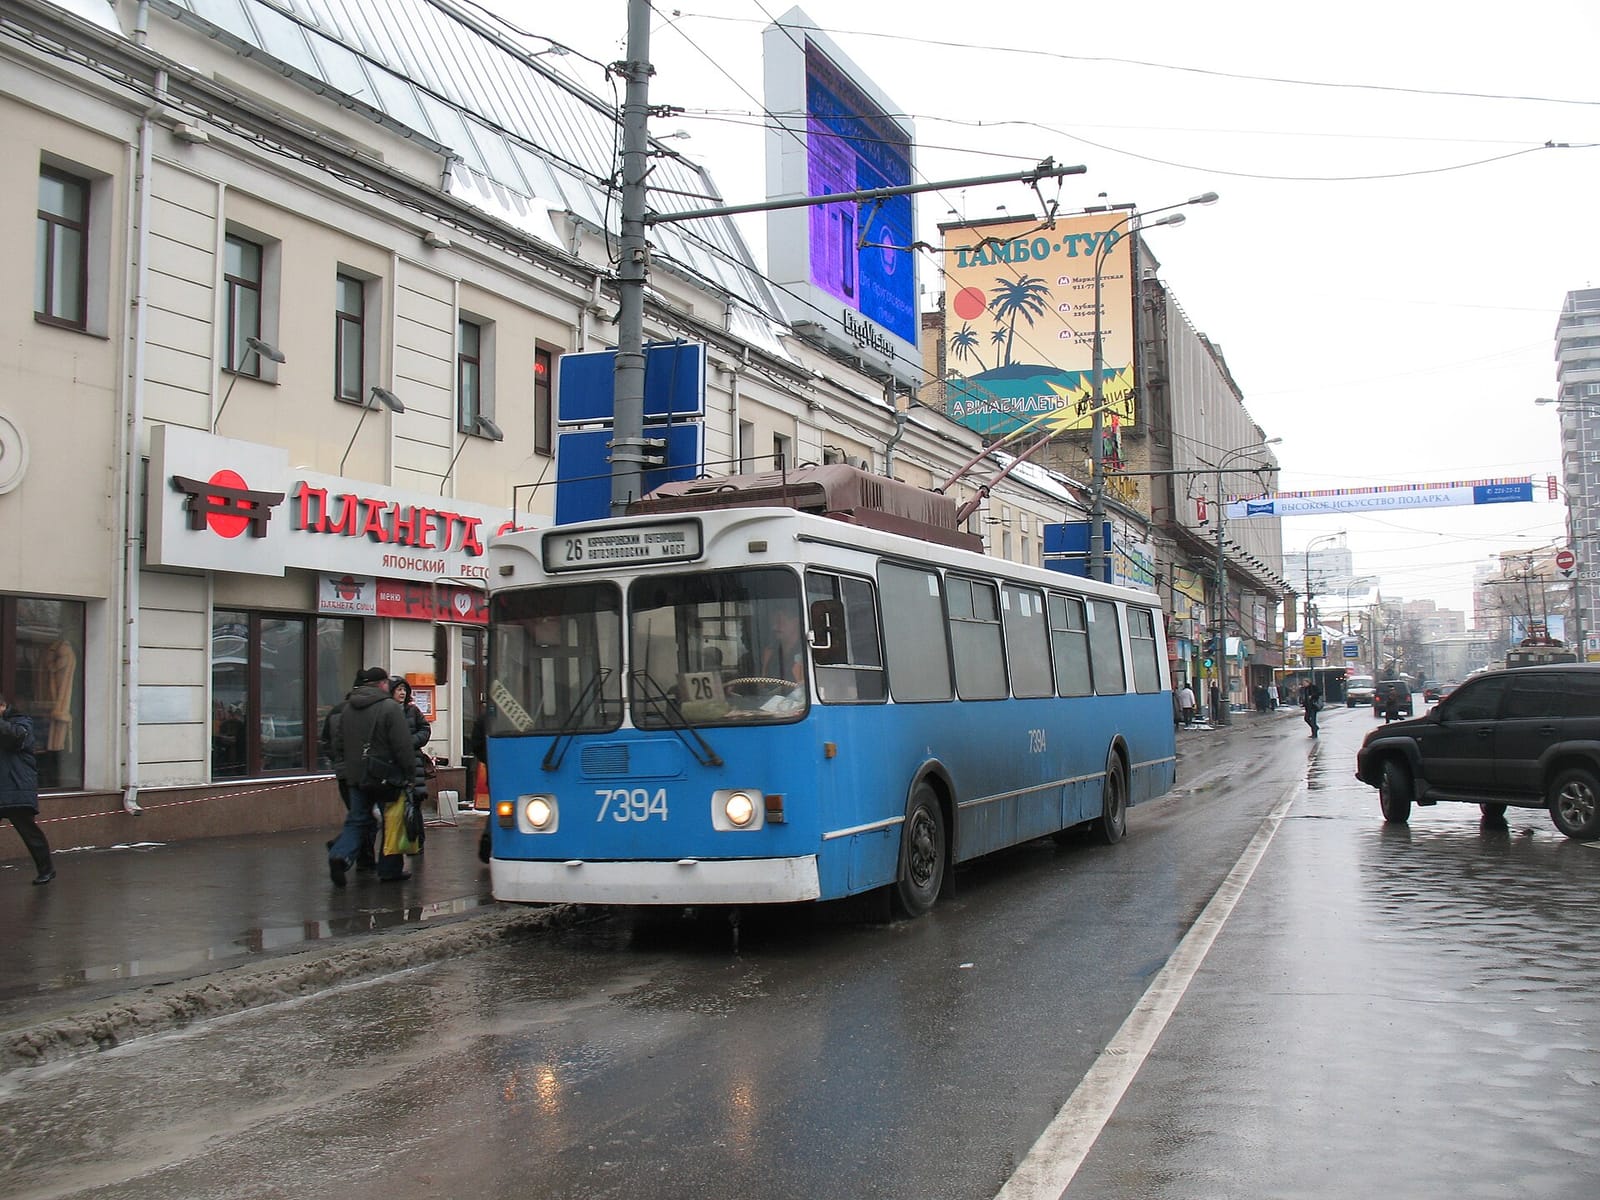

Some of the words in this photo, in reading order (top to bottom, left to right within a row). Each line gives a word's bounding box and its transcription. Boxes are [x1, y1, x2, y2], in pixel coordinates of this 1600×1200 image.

[952, 393, 1070, 417] АВИАБИЛЕТЫ
[1281, 501, 1329, 512] ВЫСОКОЕ
[1332, 497, 1394, 509] ИСКУССТВО
[1398, 493, 1450, 505] ПОДАРКА
[293, 480, 484, 557] ПЛАНЕТА
[565, 538, 583, 561] 26
[382, 554, 445, 574] ЯПОНСКИЙ
[691, 676, 713, 700] 26
[594, 788, 668, 822] 7394
